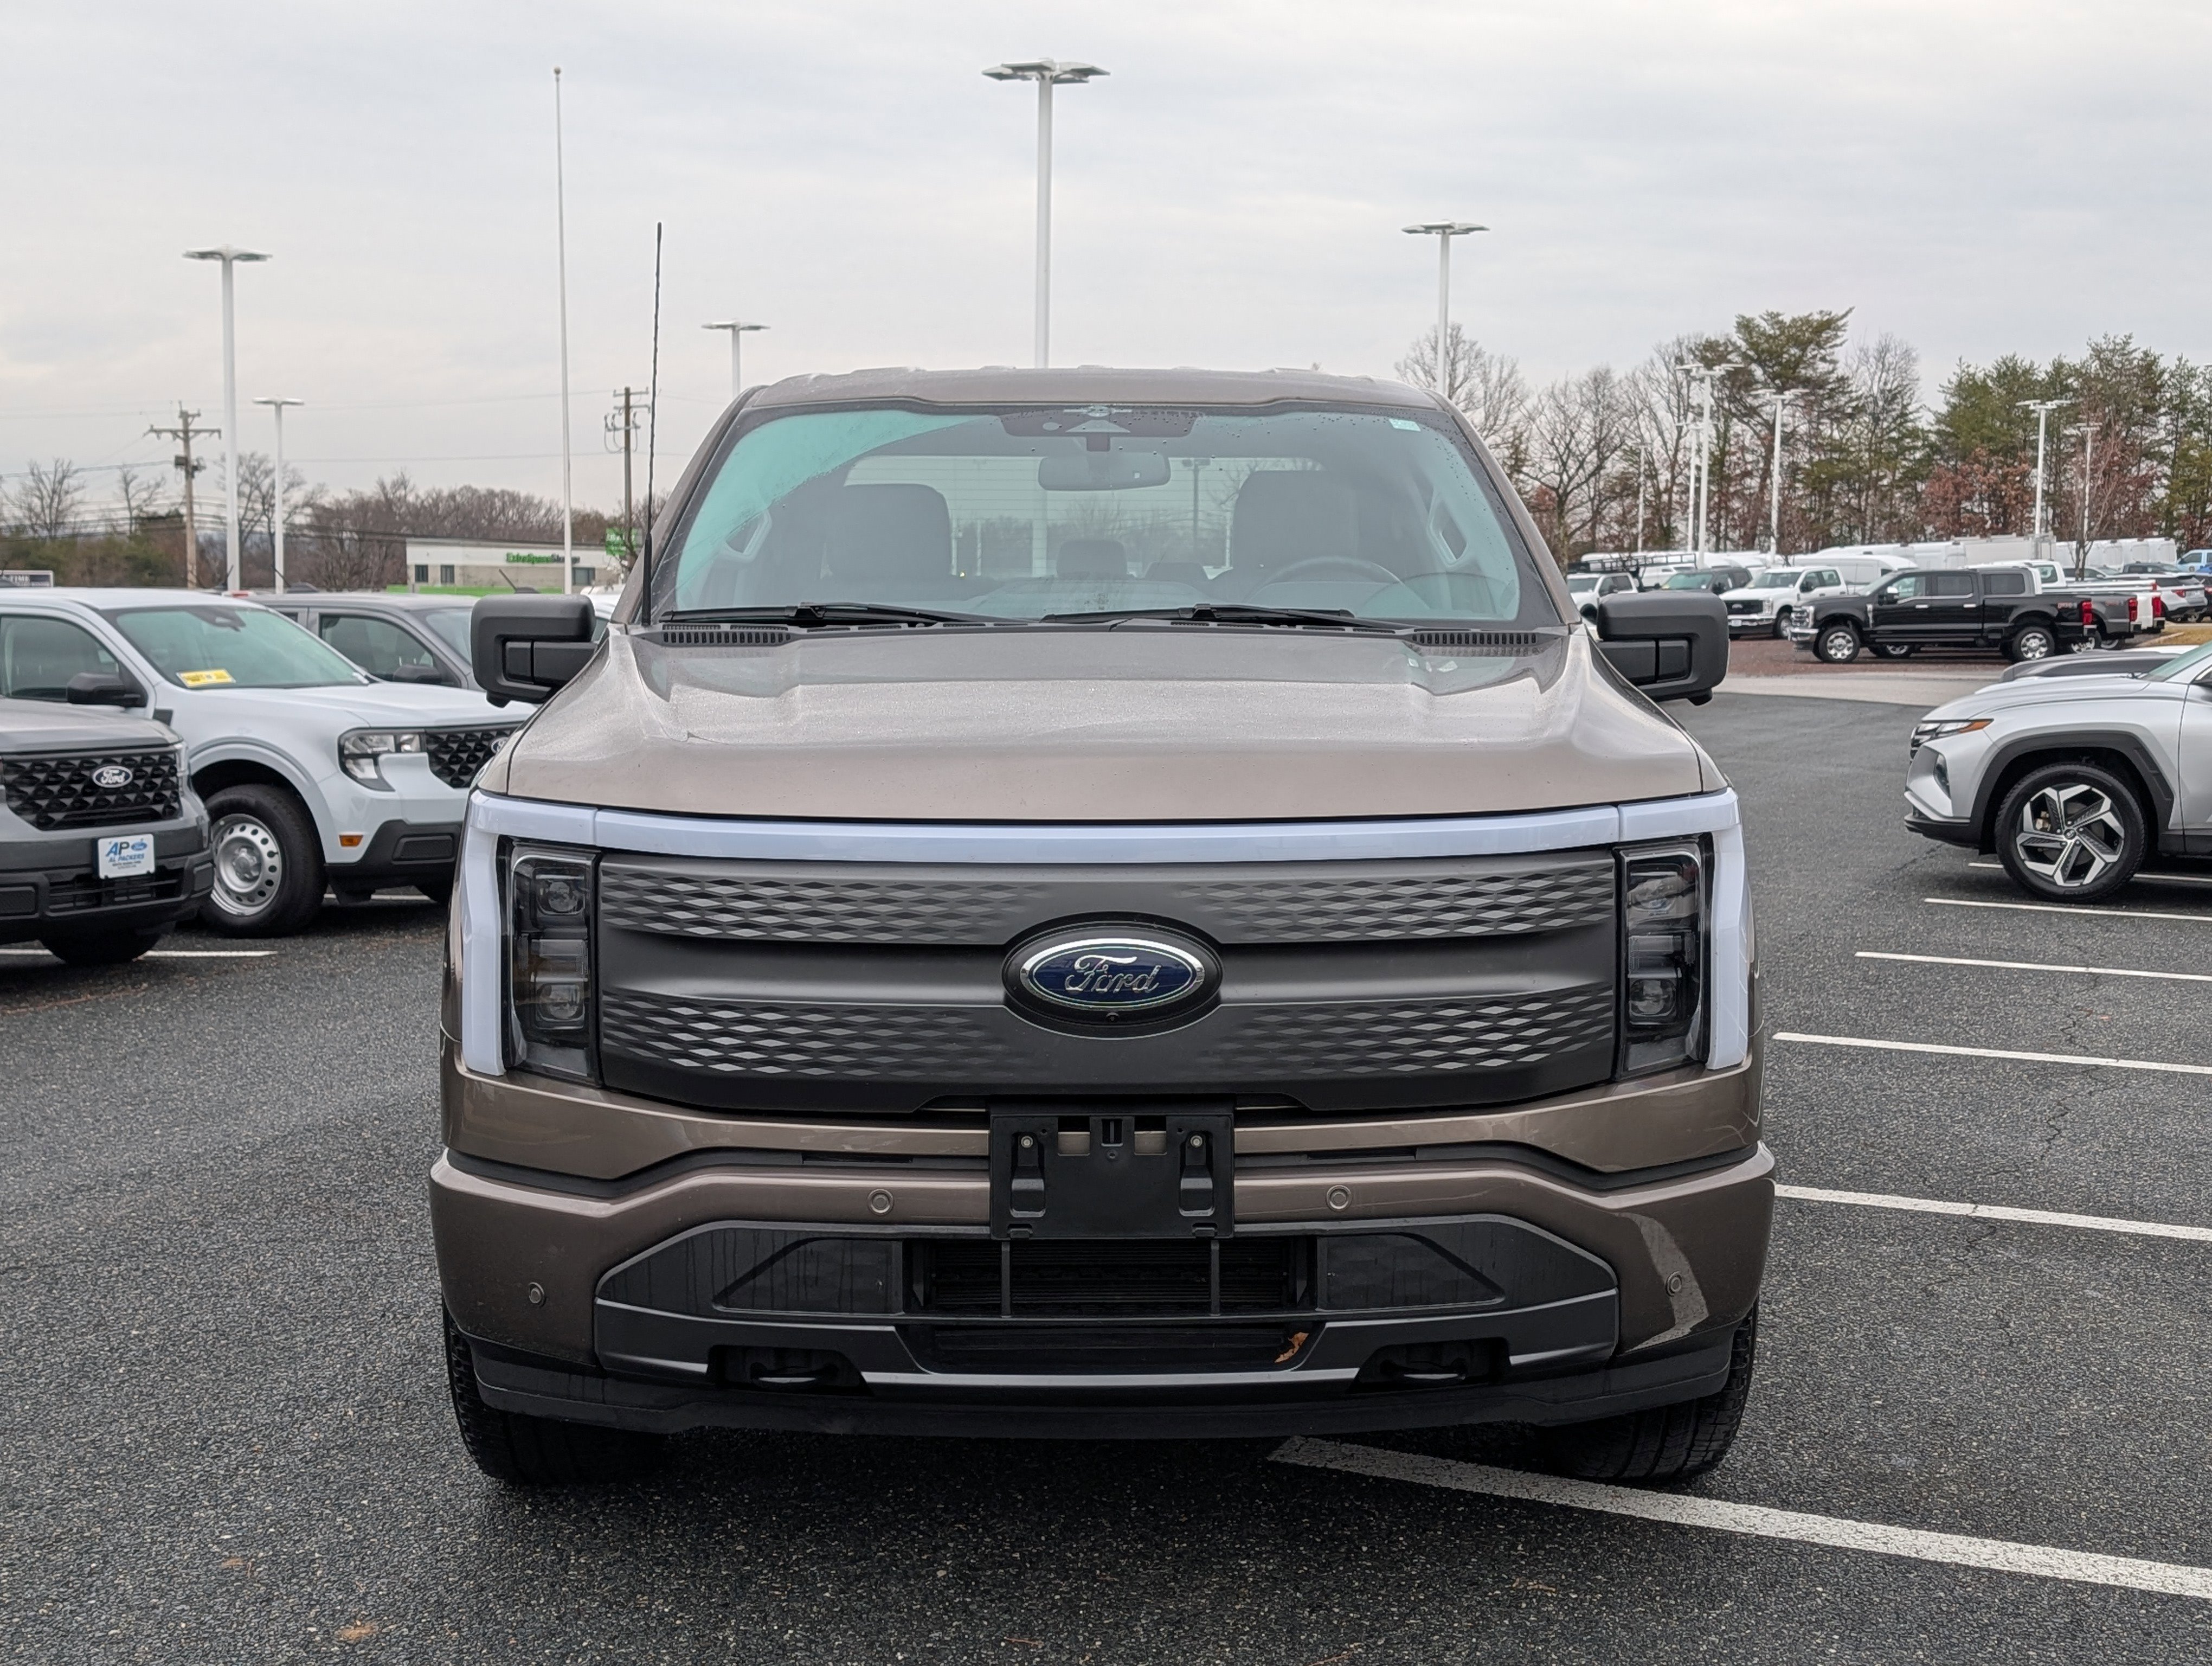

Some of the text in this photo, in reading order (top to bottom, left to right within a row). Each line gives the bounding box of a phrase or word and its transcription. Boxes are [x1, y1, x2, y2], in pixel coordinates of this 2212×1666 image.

[101, 770, 125, 784] Ford
[106, 841, 130, 856] AP
[1065, 954, 1161, 993] Ford
